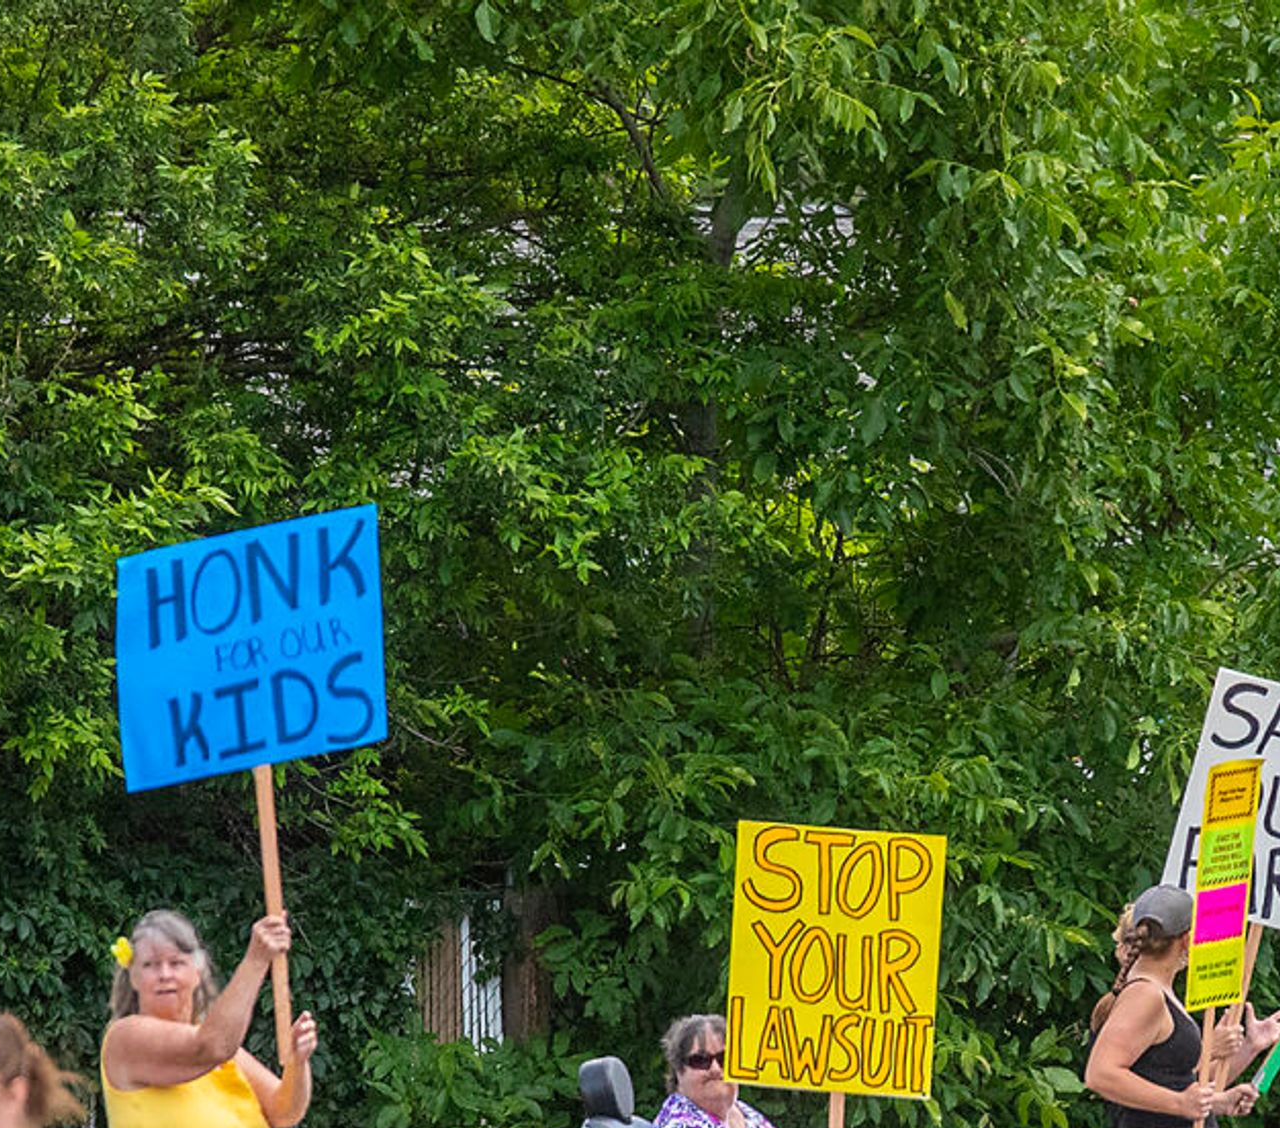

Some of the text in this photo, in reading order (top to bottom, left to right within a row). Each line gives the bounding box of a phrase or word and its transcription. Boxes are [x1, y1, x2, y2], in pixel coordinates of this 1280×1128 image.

[145, 518, 366, 650] HONK
[214, 617, 352, 672] FOR OUR
[168, 651, 374, 768] KIDS
[741, 825, 933, 922] STOP
[751, 917, 922, 1014] YOUR
[727, 996, 934, 1093] LAWSUIT
